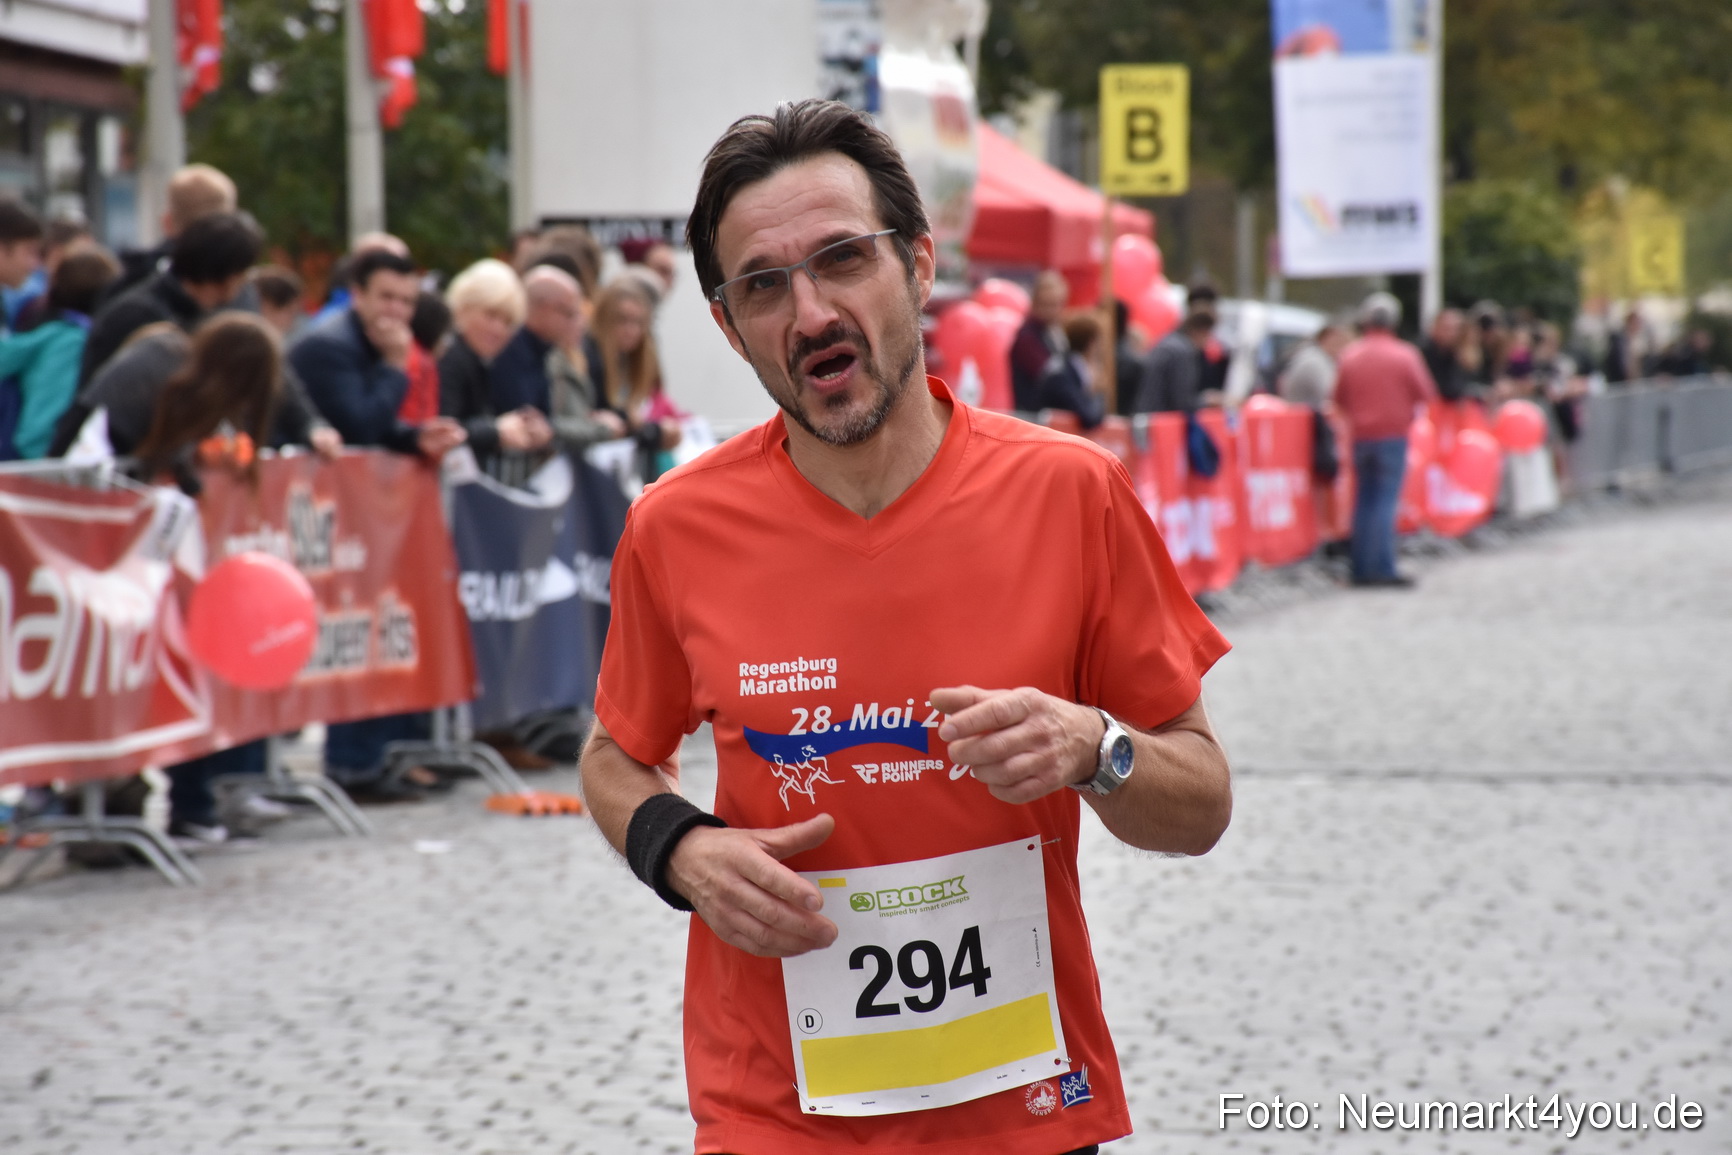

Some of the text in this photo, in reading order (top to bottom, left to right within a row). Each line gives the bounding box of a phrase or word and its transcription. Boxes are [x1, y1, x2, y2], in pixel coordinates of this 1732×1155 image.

[1126, 107, 1163, 165] B
[738, 656, 838, 679] Regensburg
[739, 674, 838, 697] Marathon
[788, 705, 842, 737] 28.
[849, 697, 915, 731] Mai
[881, 759, 944, 774] RUNNERS
[882, 770, 922, 784] POINT
[876, 875, 968, 909] BOCK
[879, 908, 908, 918] inspired
[919, 904, 940, 913] smart
[941, 895, 970, 907] concepts
[849, 925, 992, 1019] 294
[805, 1014, 815, 1028] D
